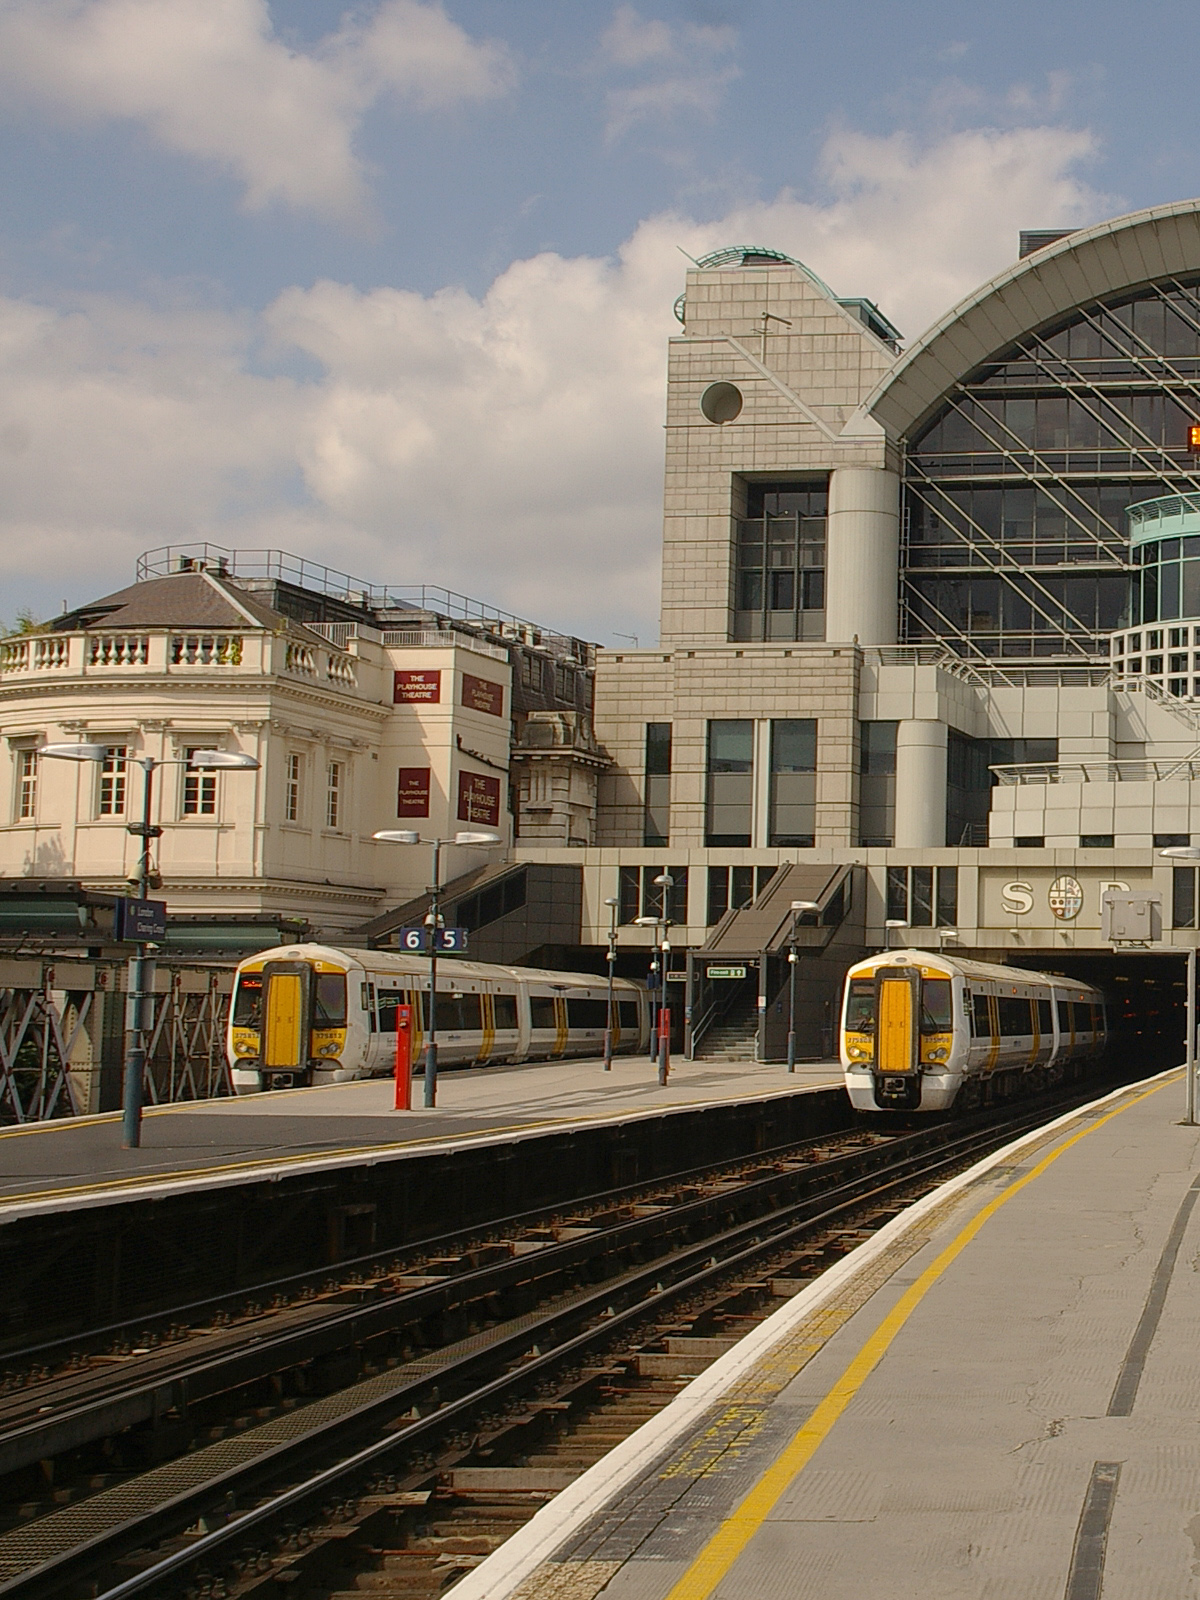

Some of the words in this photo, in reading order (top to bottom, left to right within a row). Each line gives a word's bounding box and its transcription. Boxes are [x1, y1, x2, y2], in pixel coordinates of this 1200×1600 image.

[397, 683, 437, 691] PLAYHOUSE
[402, 691, 432, 699] THEATRE
[474, 778, 486, 790] THE
[463, 791, 496, 806] PLAYHOUSE
[466, 806, 491, 820] THEATRE
[406, 930, 420, 949] 6
[442, 930, 456, 948] 5
